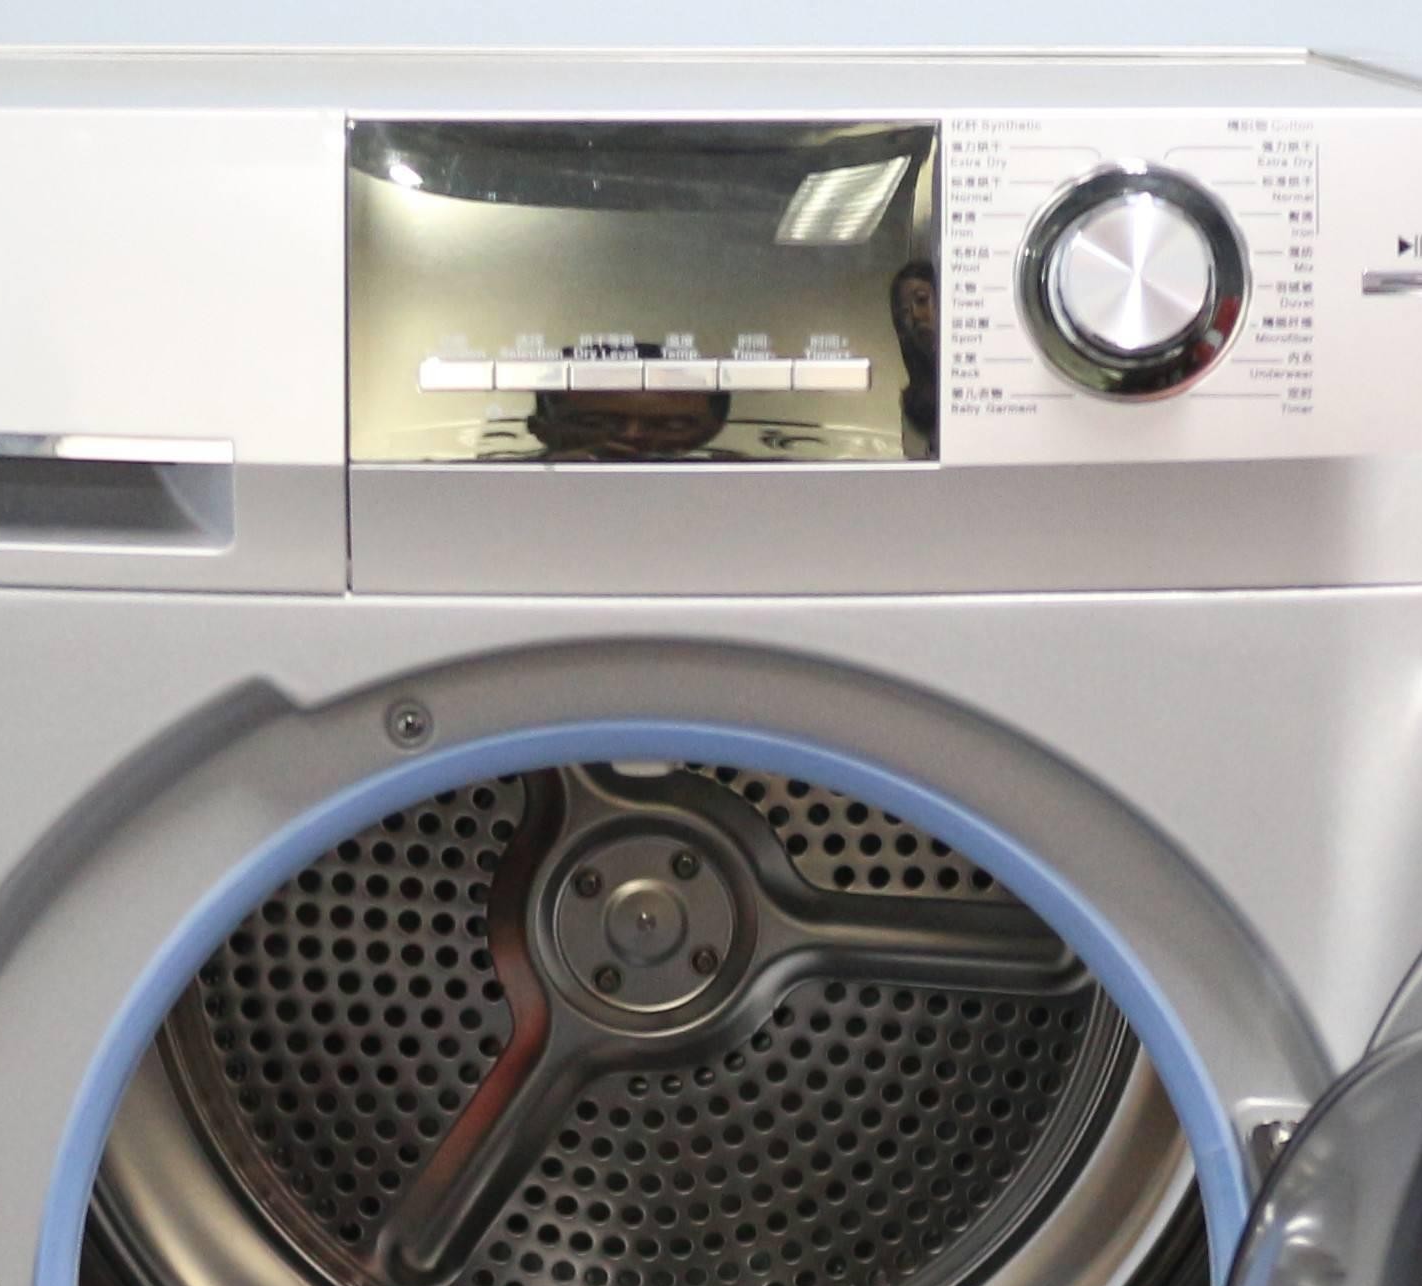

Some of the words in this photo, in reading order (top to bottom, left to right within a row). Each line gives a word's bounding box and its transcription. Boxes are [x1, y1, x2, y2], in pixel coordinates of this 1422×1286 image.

[986, 157, 1007, 171] Dry
[950, 191, 993, 202] Normal
[1272, 191, 1314, 202] Normal
